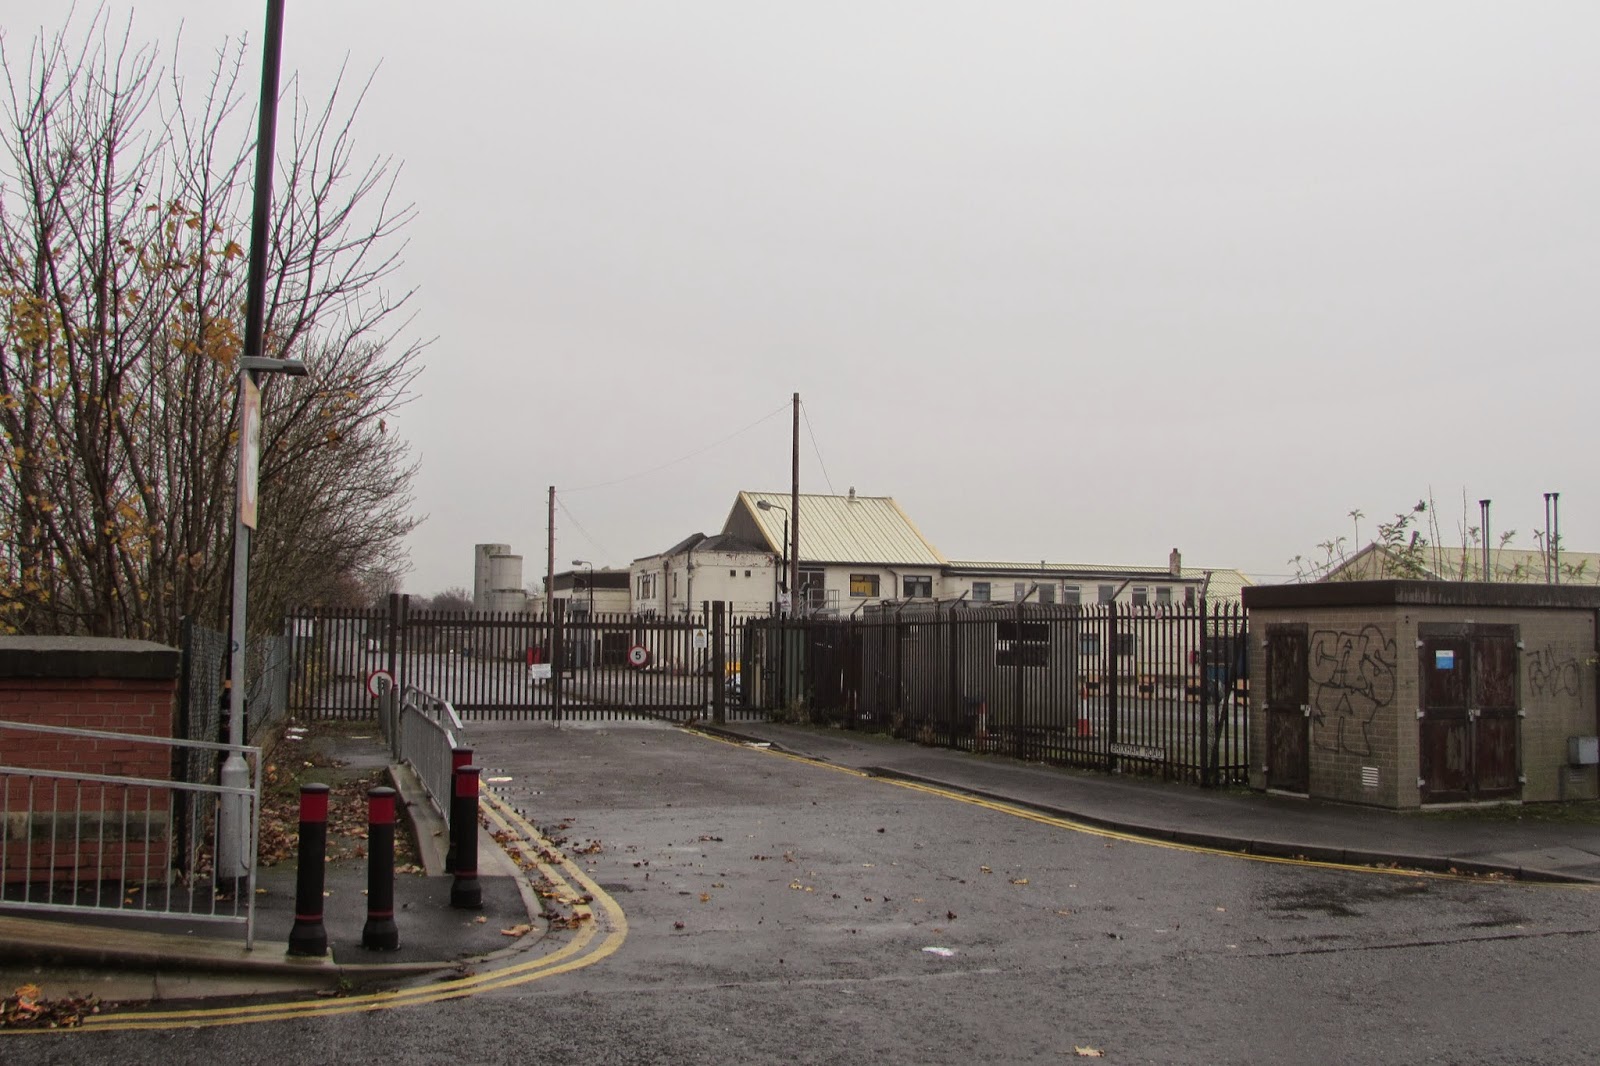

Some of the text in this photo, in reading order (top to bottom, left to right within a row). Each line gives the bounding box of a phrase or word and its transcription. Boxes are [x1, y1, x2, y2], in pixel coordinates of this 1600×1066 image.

[635, 651, 641, 660] 5
[1111, 743, 1162, 758] BRIXHAM ROAD
